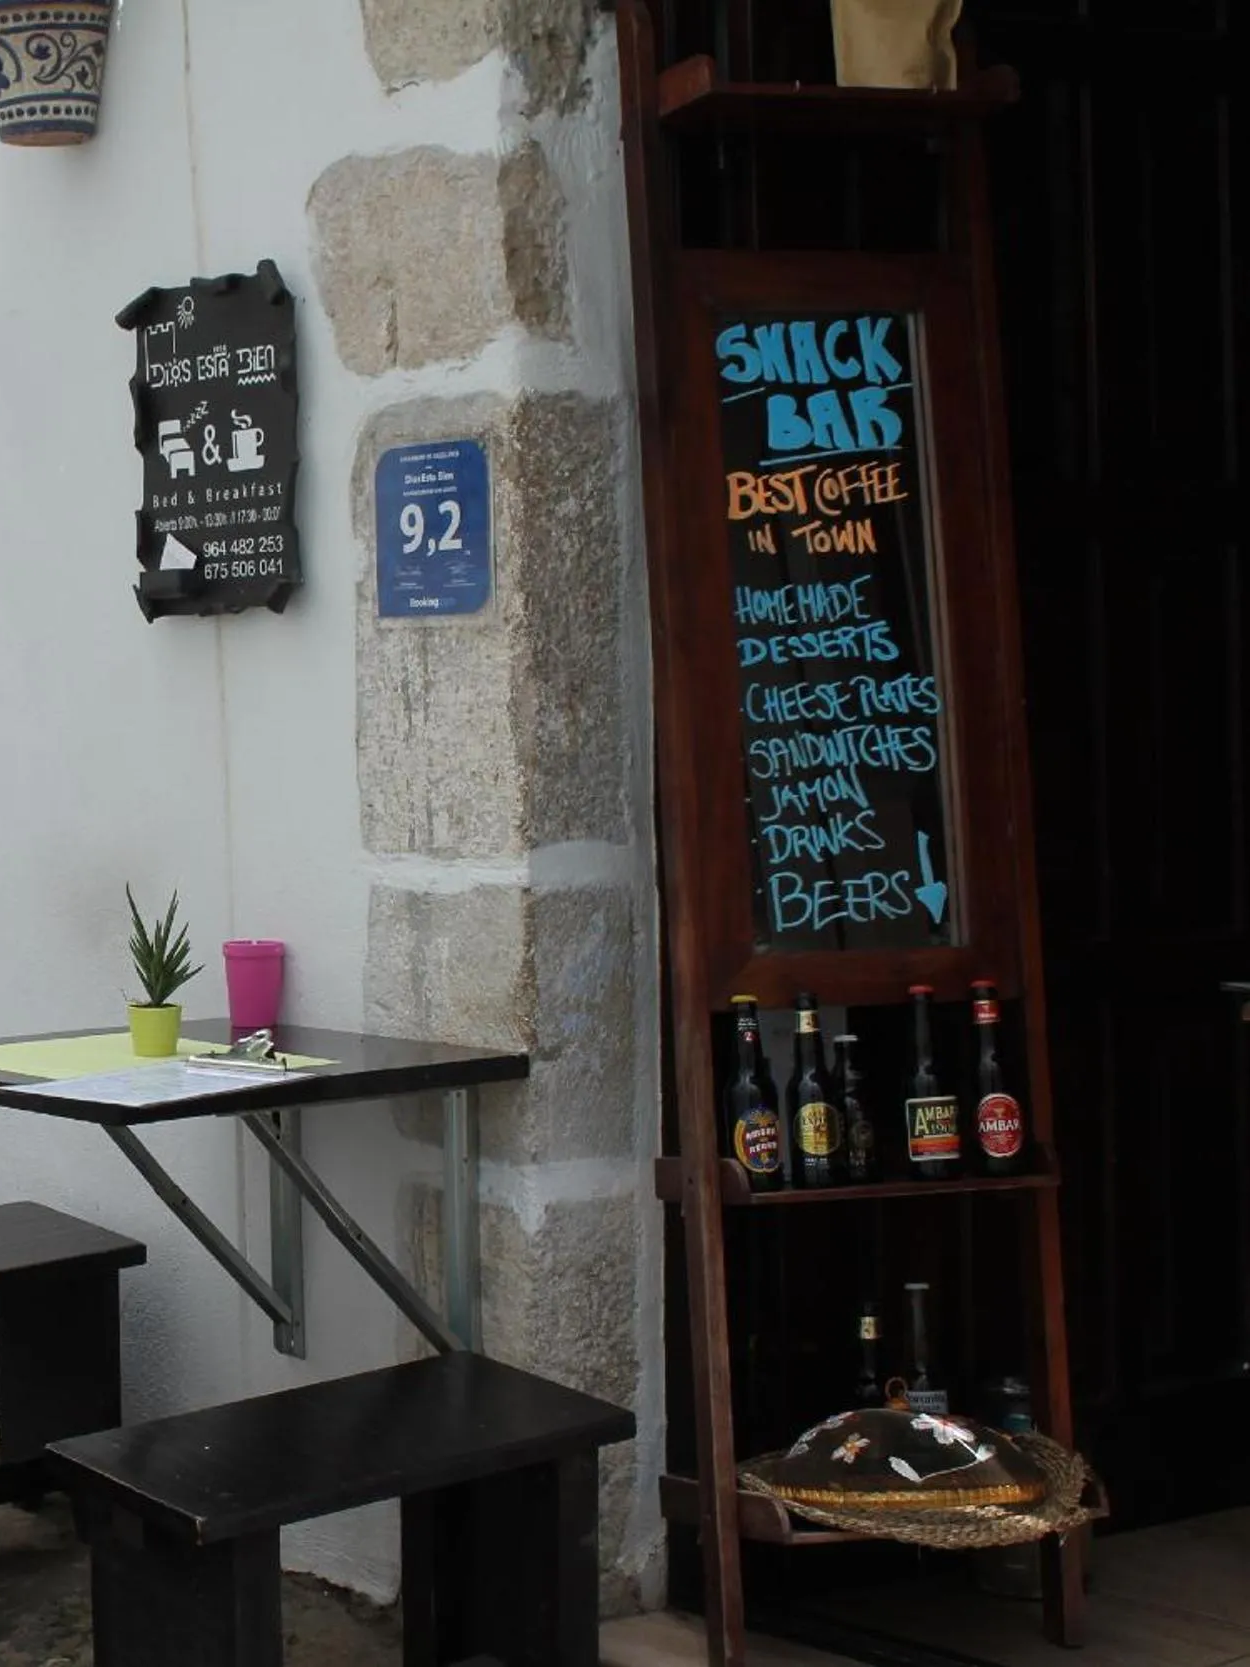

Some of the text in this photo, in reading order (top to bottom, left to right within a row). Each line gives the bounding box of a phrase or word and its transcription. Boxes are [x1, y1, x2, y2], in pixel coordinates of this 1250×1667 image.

[716, 316, 903, 384] SNACK
[767, 387, 902, 451] BAR
[153, 491, 178, 508] Bed
[206, 482, 282, 503] Breakfast
[726, 461, 908, 520] BEST COFFEE
[203, 535, 283, 558] 964 482 253
[400, 500, 463, 557] 9,2
[748, 518, 878, 555] IN TOWN
[204, 558, 283, 579] 675 506 041
[736, 620, 899, 668] DESSERTS
[746, 672, 942, 724] CHEESE PLATES
[750, 724, 937, 779] SANDWITCHES
[759, 764, 868, 822] JAMON
[761, 809, 886, 864] DRINKS
[768, 870, 913, 932] BEERS
